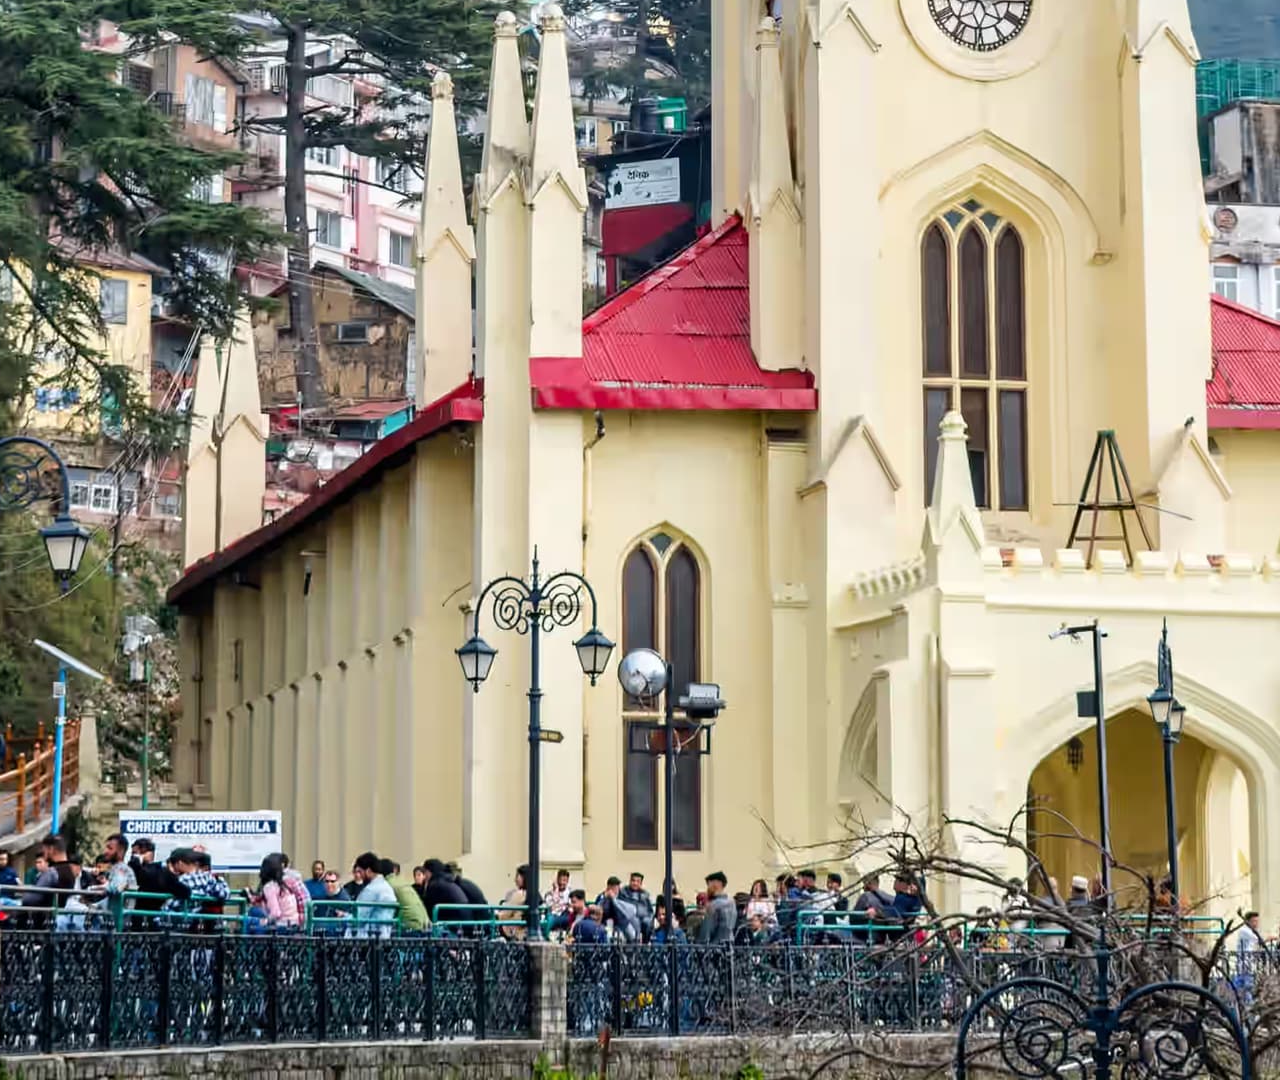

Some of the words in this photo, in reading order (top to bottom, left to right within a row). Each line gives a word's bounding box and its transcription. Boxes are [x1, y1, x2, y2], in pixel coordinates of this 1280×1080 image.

[126, 821, 170, 833] CHRIST
[173, 821, 223, 833] CHURCH
[226, 821, 271, 833] SHIMLA
